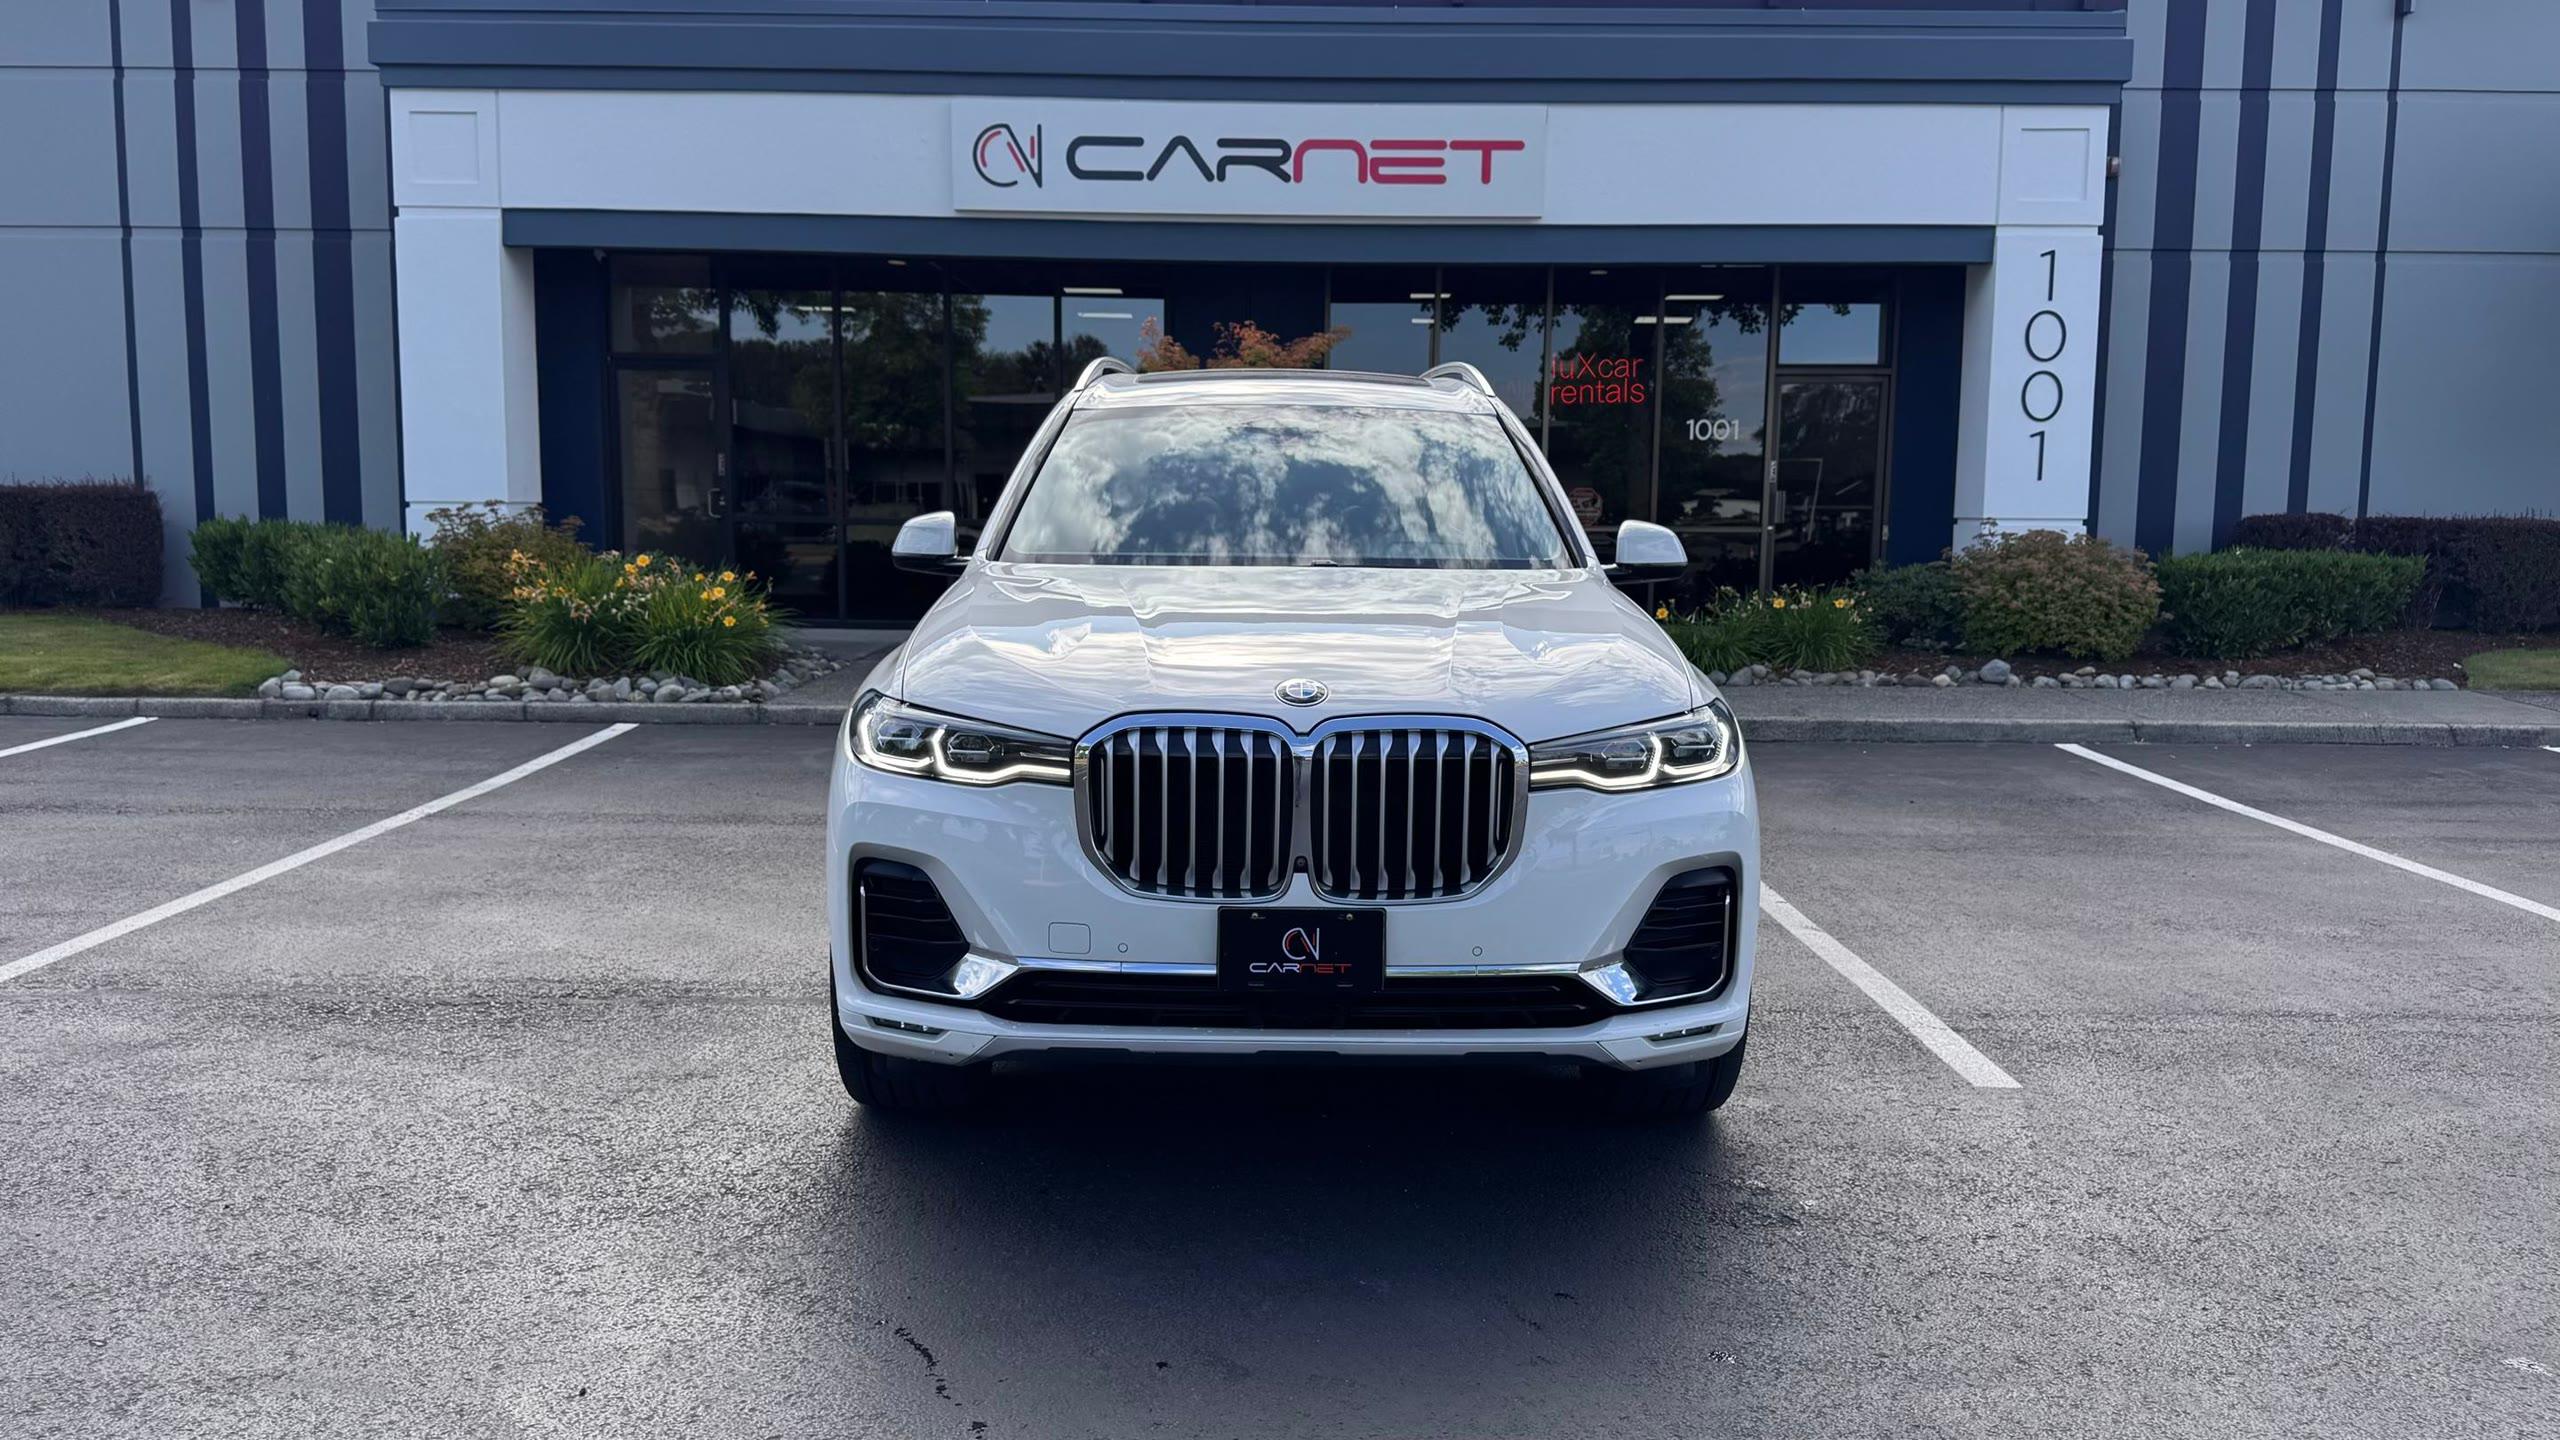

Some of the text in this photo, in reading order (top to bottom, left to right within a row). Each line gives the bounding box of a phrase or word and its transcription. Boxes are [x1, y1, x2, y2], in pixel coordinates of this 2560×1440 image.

[1065, 135, 1526, 185] CARNET
[2020, 249, 2068, 482] 1001
[1551, 378, 1646, 405] rentals
[1685, 418, 1740, 441] 1001
[1249, 962, 1353, 974] CARNET
